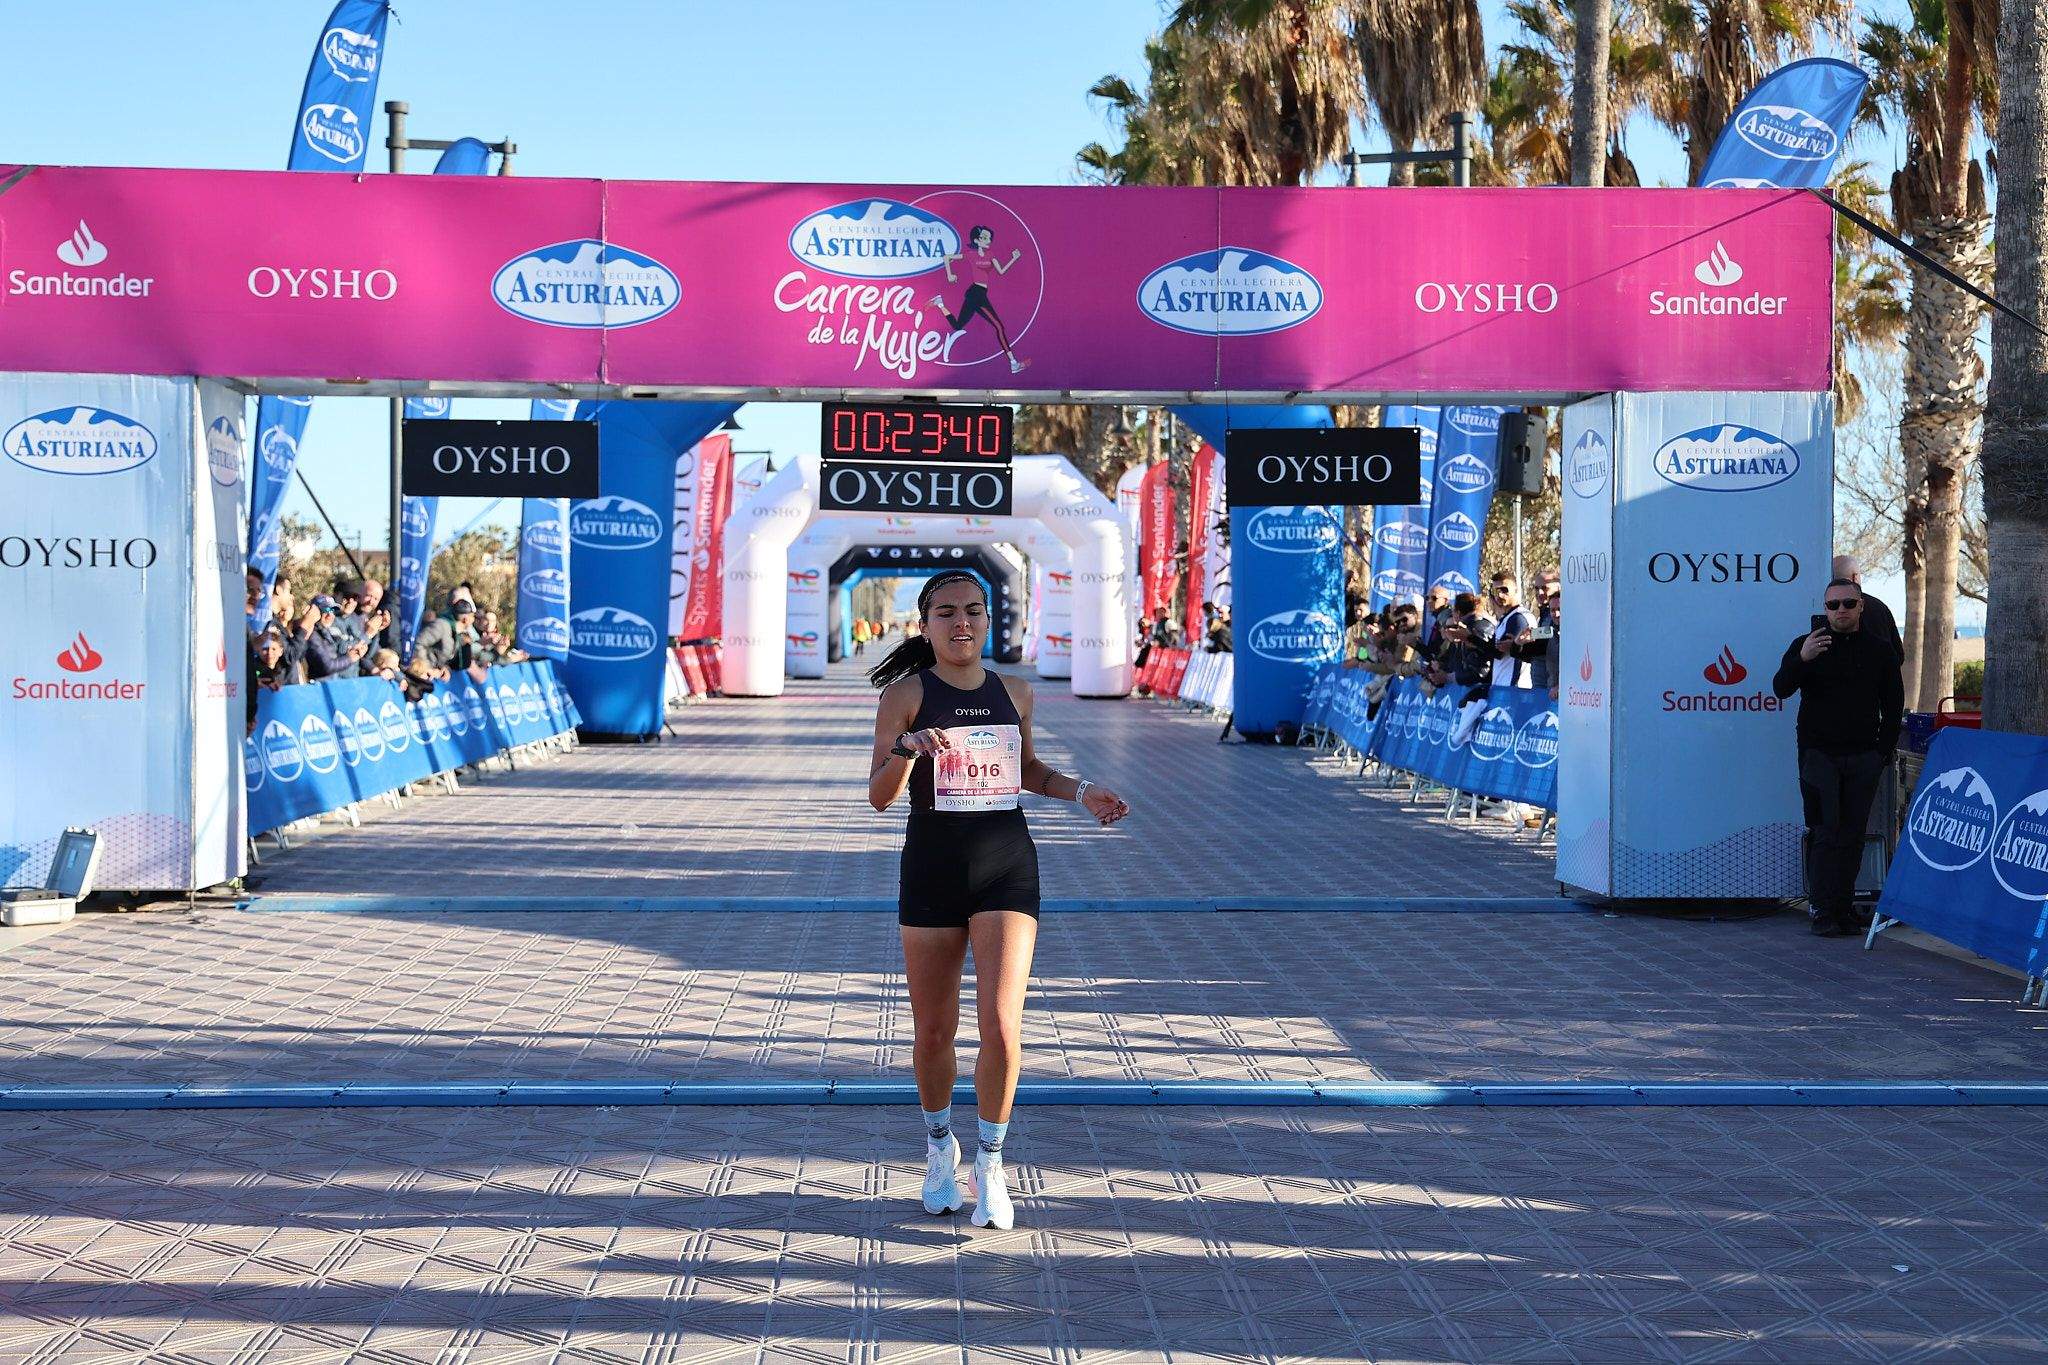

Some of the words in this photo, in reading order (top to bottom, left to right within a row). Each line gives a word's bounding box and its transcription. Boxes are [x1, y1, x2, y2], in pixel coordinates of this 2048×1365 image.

[1741, 114, 1828, 155] ASTURIANA
[803, 227, 946, 258] ASTURIANA
[829, 226, 883, 235] CENTRAL
[888, 227, 943, 236] LECHERA
[9, 270, 153, 298] Santander
[247, 265, 398, 301] OYSHO
[507, 271, 666, 306] ASTURIANA
[773, 271, 916, 315] Carrera
[1152, 280, 1309, 312] ASTURIANA
[1180, 279, 1238, 287] CENTRAL
[1244, 279, 1303, 287] LECHERA
[1414, 282, 1559, 313] OYSHO
[1649, 291, 1787, 316] Santander
[807, 315, 835, 345] de
[839, 314, 859, 345] la
[853, 310, 967, 380] Mujer
[15, 430, 146, 458] ASTURIANA
[833, 411, 1001, 455] 00:23:40
[432, 445, 571, 475] OYSHO
[1257, 454, 1393, 483] OYSHO
[1664, 448, 1790, 475] ASTURIANA
[698, 460, 716, 547] Santander
[829, 468, 1004, 509] OYSHO
[571, 515, 657, 538] ASTURIANA
[0, 536, 157, 570] OYSHO
[866, 547, 964, 559] VOLVO
[1567, 552, 1607, 584] OYSHO
[1648, 552, 1800, 584] OYSHO
[12, 677, 145, 699] Santander
[1662, 691, 1783, 712] Santander
[955, 708, 991, 716] OYSHO
[967, 763, 1000, 778] 016
[1913, 795, 1987, 853] ASTURIANA
